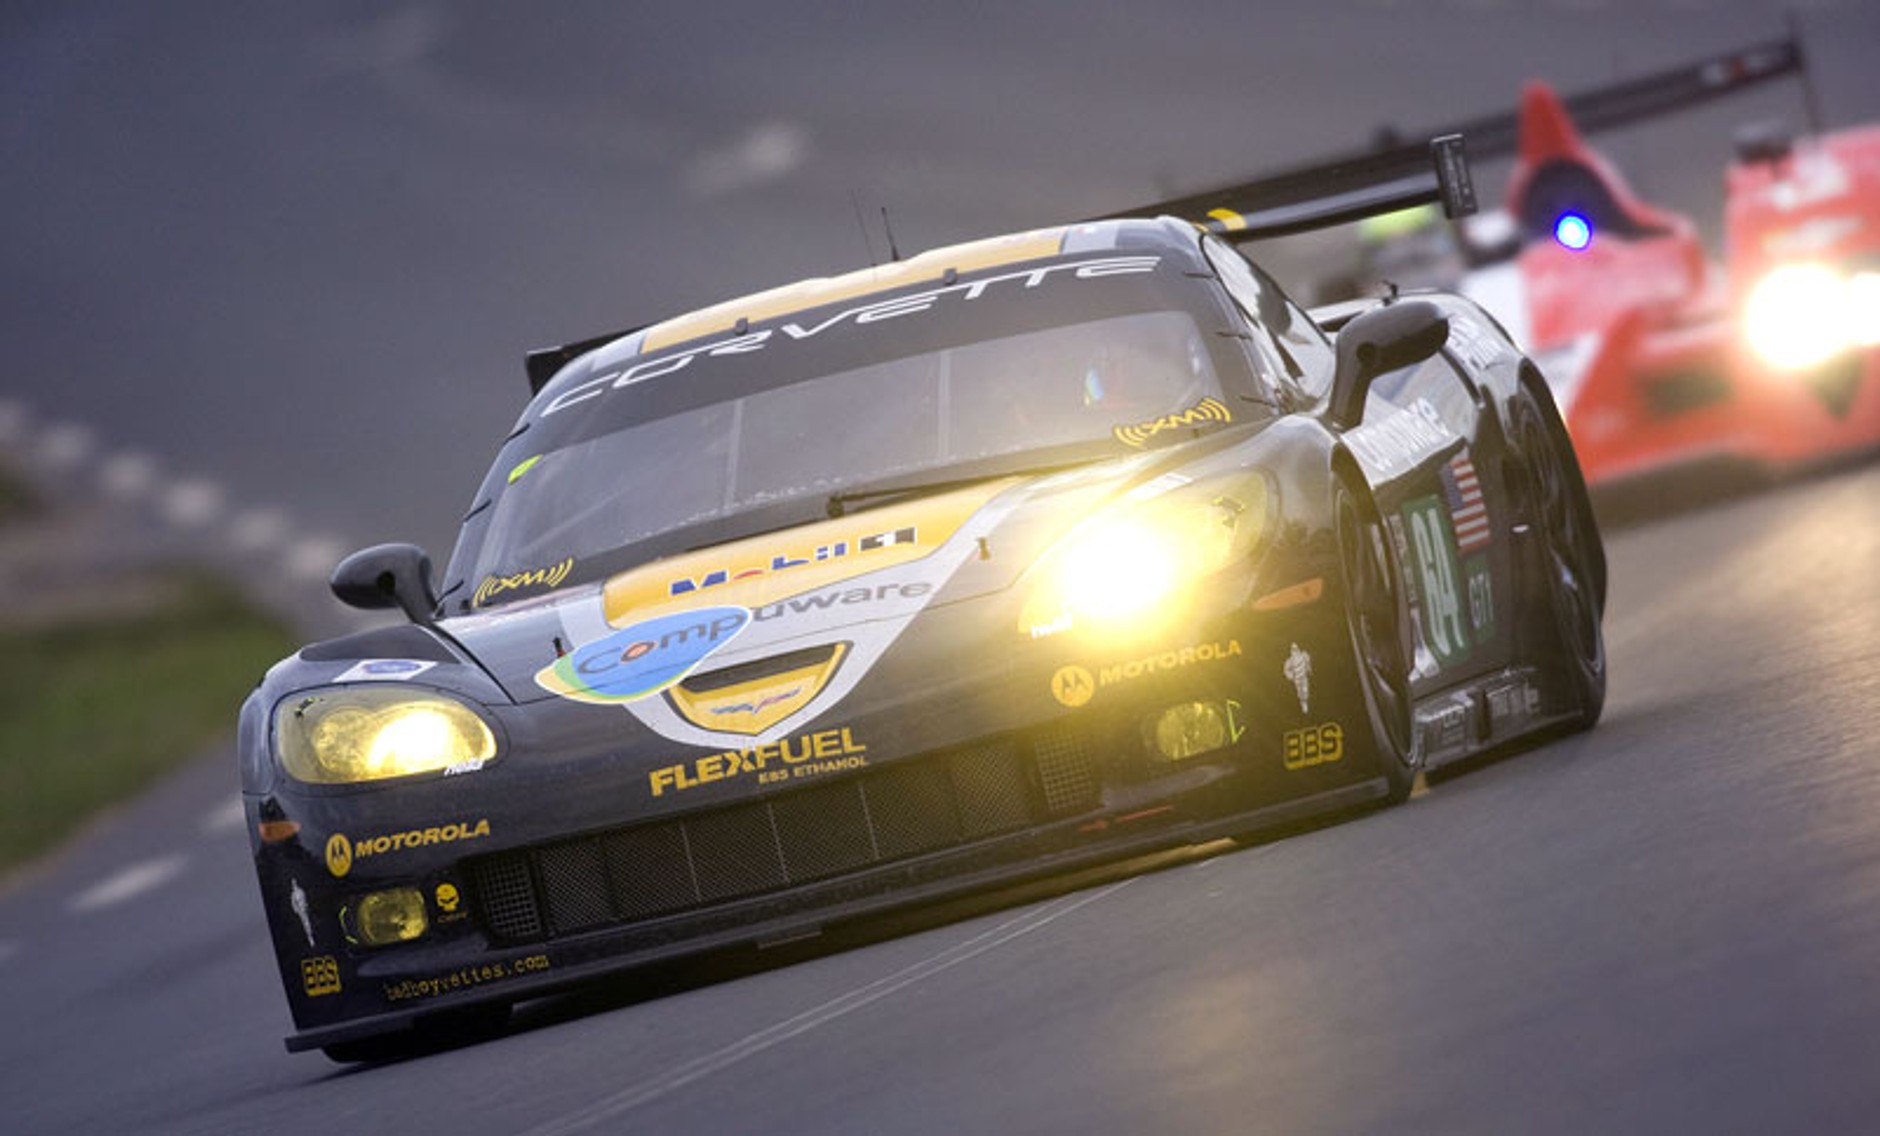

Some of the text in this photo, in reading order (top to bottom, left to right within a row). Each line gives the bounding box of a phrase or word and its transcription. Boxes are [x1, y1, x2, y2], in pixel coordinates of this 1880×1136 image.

[540, 256, 1161, 418] CORVETTE
[578, 580, 934, 676] Compuware
[1099, 639, 1243, 687] MOTOROLA
[648, 726, 867, 797] FLEXFUEL
[1283, 722, 1344, 771] BBS
[354, 818, 491, 859] MOTOROLA
[301, 955, 342, 998] BBS
